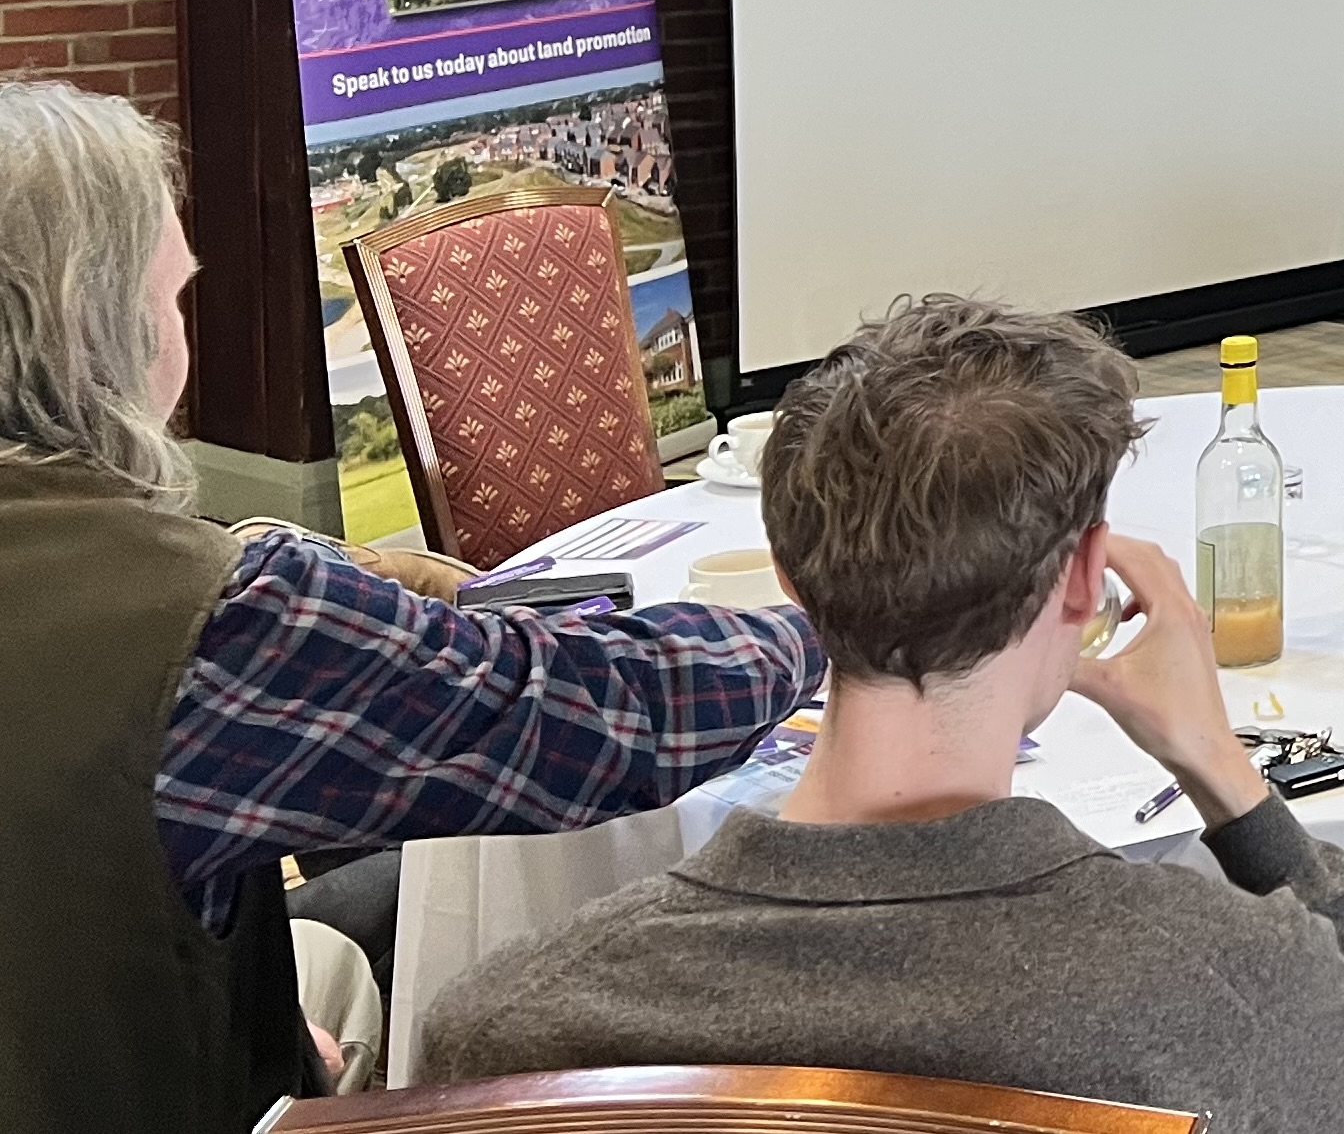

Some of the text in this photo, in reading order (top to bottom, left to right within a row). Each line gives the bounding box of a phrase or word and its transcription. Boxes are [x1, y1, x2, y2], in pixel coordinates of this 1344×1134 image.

[332, 25, 652, 98] Speak to us today about land promotion
